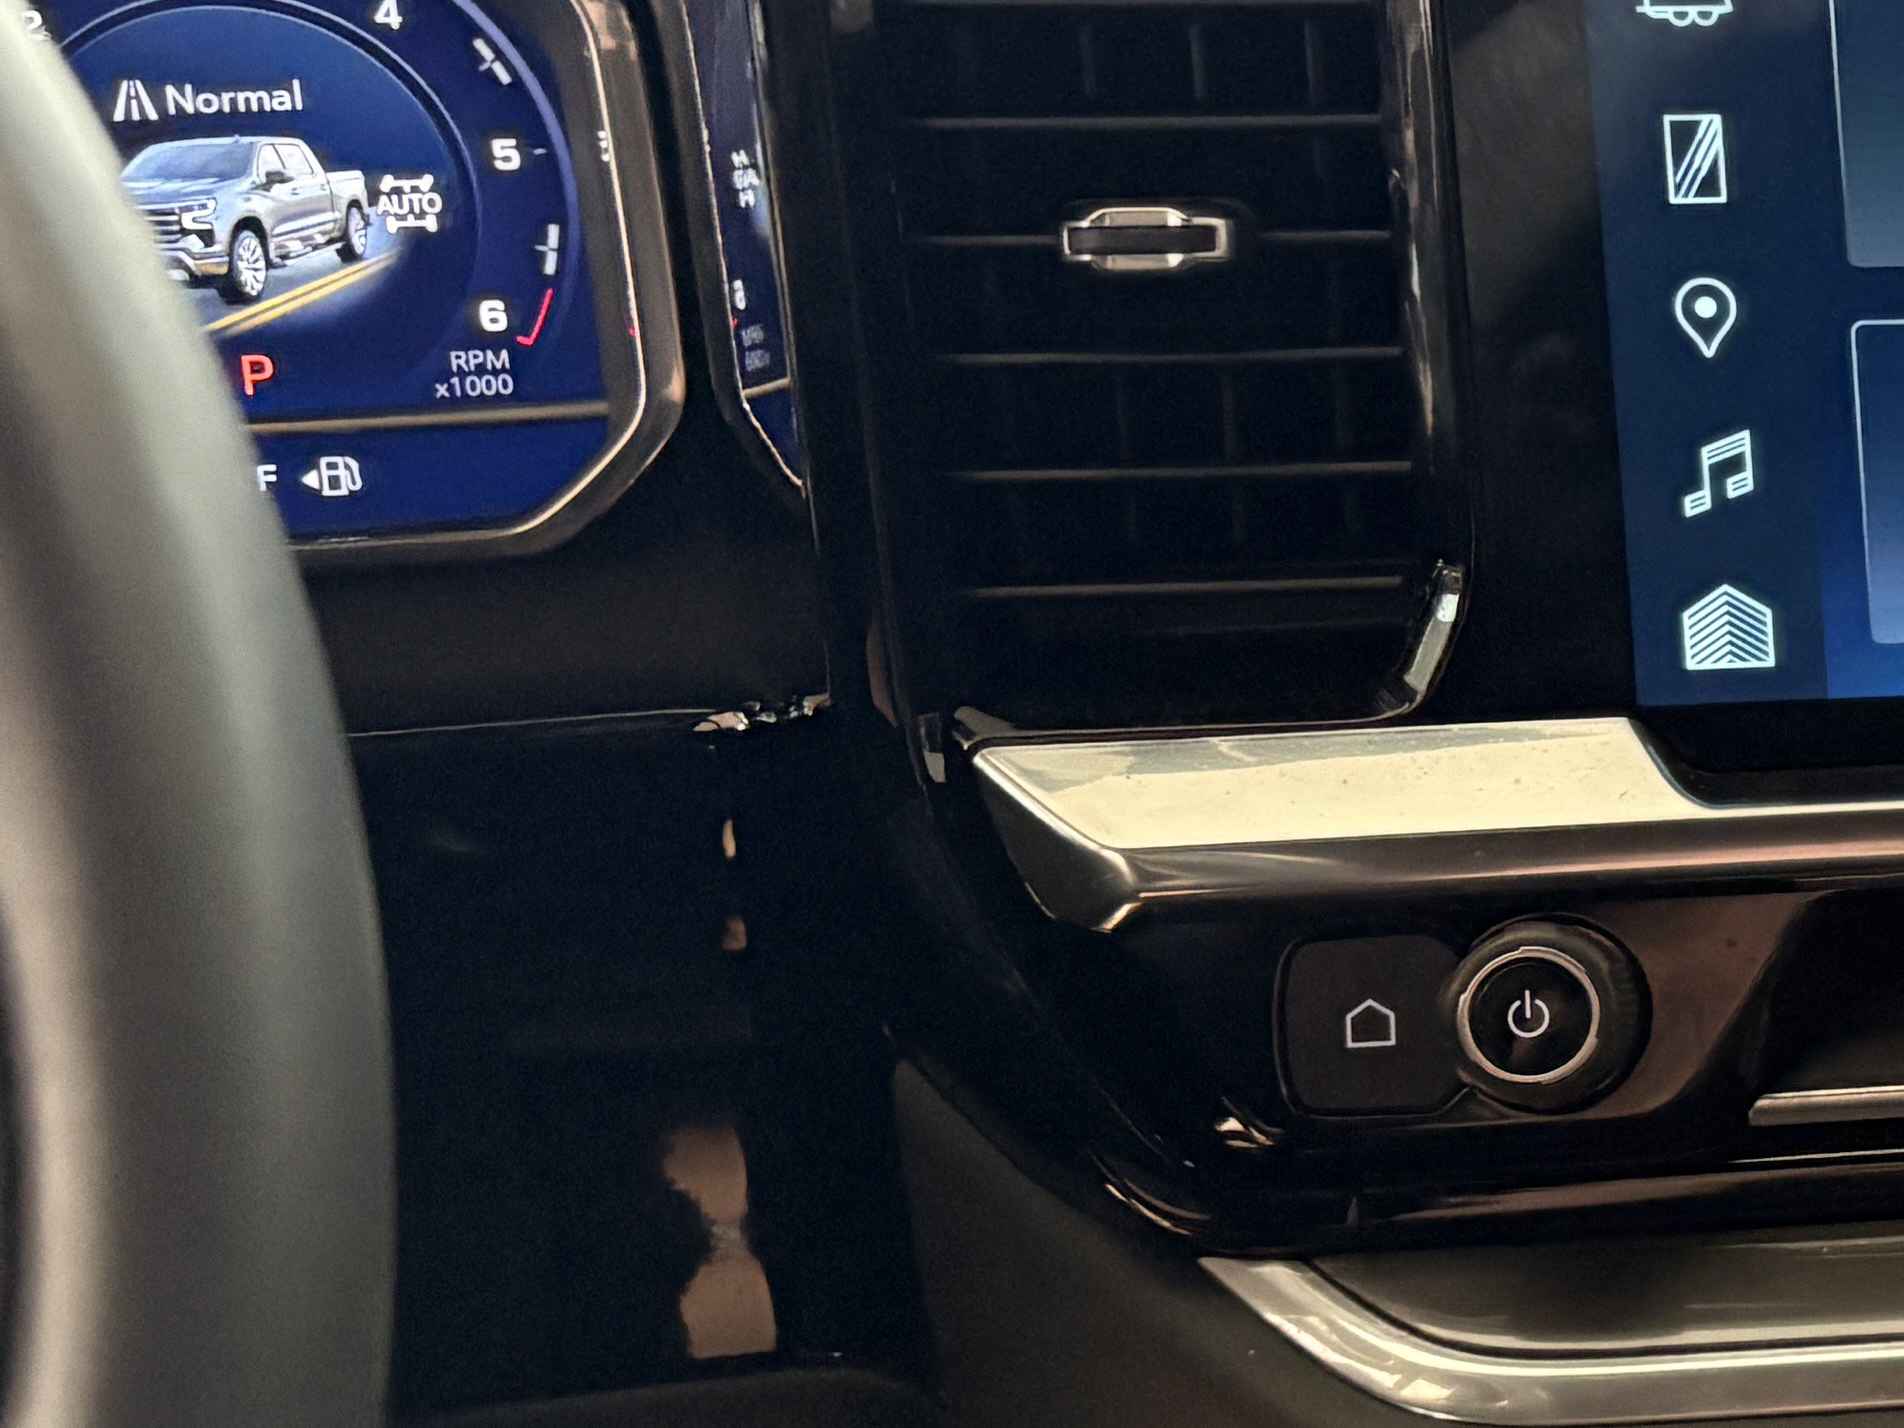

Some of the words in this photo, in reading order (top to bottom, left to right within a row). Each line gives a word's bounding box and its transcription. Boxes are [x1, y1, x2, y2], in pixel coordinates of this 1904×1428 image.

[164, 78, 303, 115] Normal
[491, 138, 521, 171] 5
[376, 191, 442, 218] AUTO
[478, 299, 508, 332] 6
[240, 354, 274, 396] P
[449, 348, 510, 373] RPM
[434, 375, 514, 398] x1000
[256, 463, 278, 492] F
